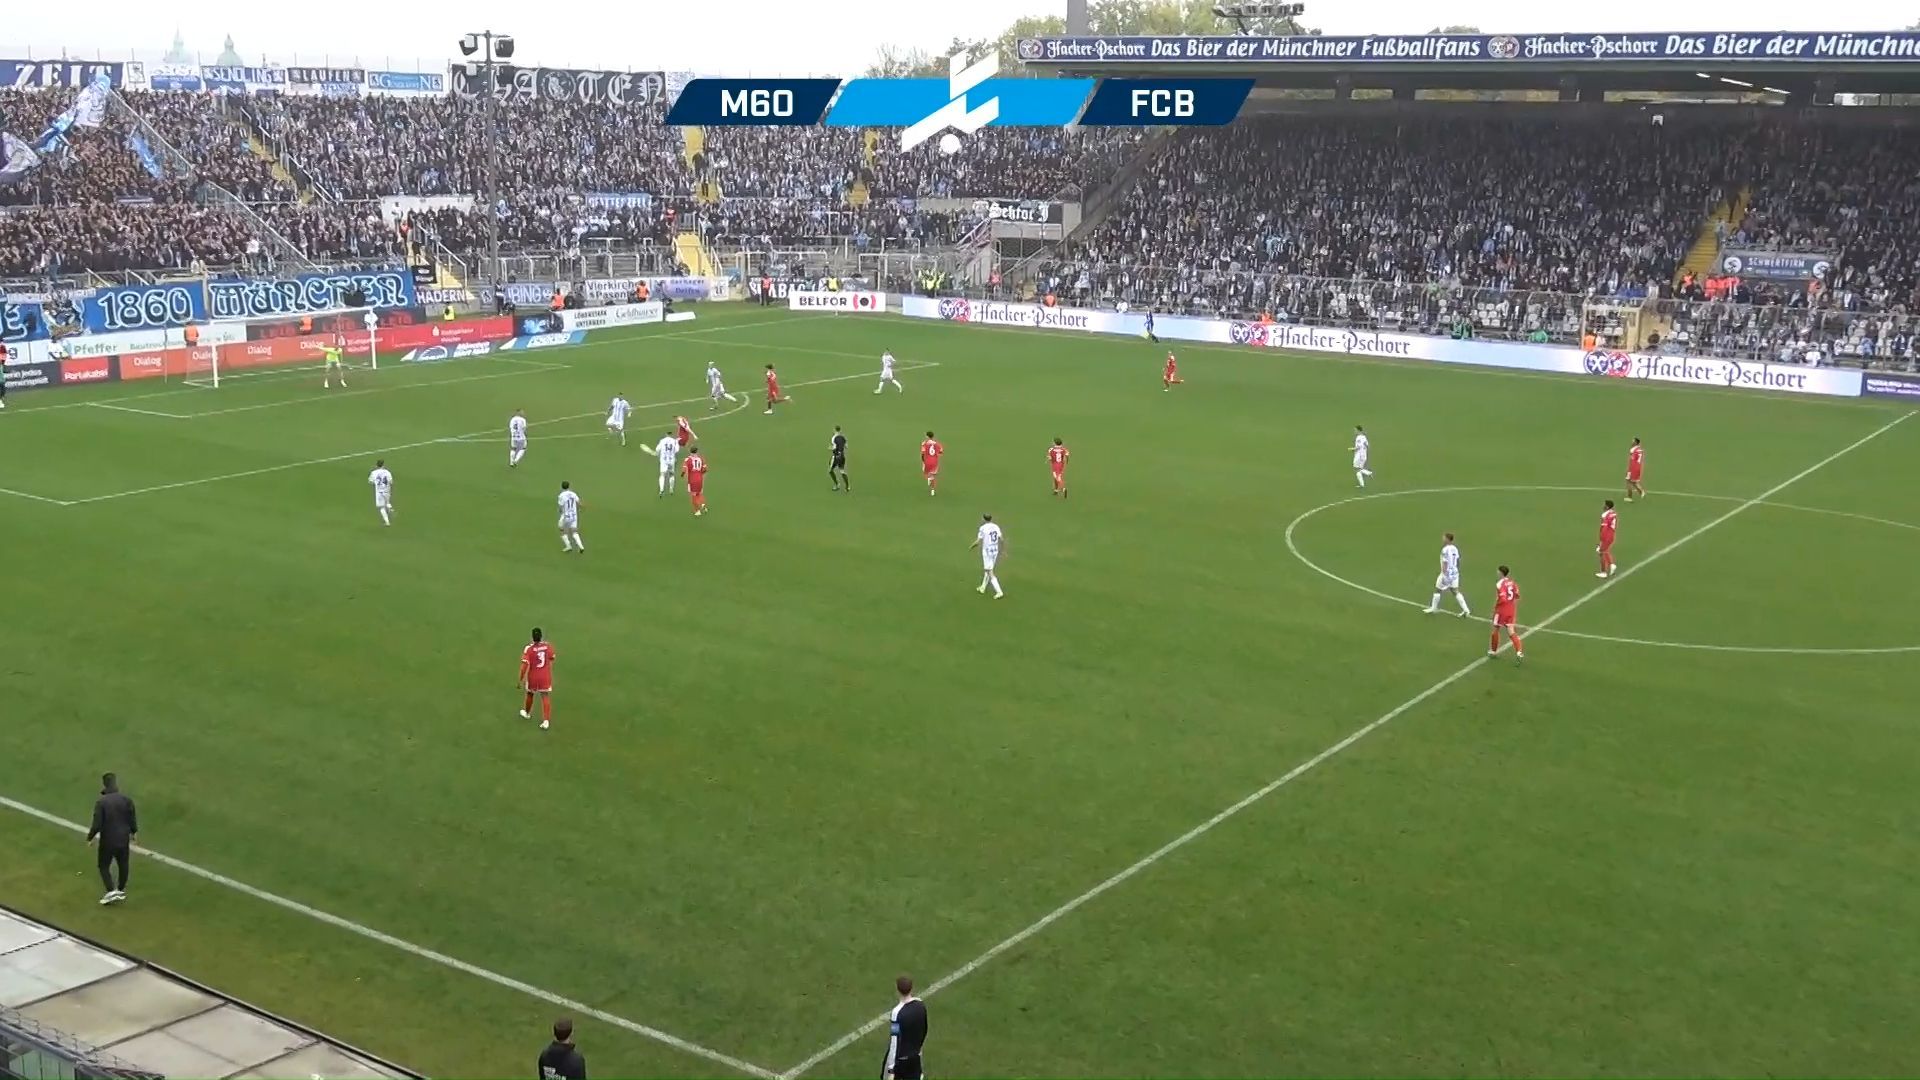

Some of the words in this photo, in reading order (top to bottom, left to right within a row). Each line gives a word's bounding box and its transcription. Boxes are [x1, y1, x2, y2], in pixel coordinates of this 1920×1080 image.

[1047, 38, 1145, 60] Hacker-Pschorr
[1151, 38, 1181, 57] Das
[1186, 38, 1220, 57] Bier
[1226, 38, 1258, 57] der
[1262, 37, 1359, 57] Münchner
[1361, 37, 1481, 60] Fußballfans
[1524, 35, 1658, 59] Hacker-Pschorr
[1665, 35, 1706, 55] Das
[1712, 33, 1762, 56] Bier
[1765, 34, 1809, 55] der
[14, 62, 112, 90] ZEIT
[213, 66, 273, 83] SENDLING
[416, 289, 466, 304] HADERN
[799, 296, 847, 306] BELFOR
[97, 287, 193, 329] 1860
[973, 301, 1089, 328] Hacker-Pschorr
[1273, 326, 1411, 355] Hacker-Pschorr
[133, 356, 162, 368] Dialog
[1636, 356, 1807, 388] Hacker-Pschorr
[928, 445, 936, 456] 6
[988, 531, 998, 543] 13
[1507, 584, 1514, 601] 5
[536, 651, 546, 668] 3
